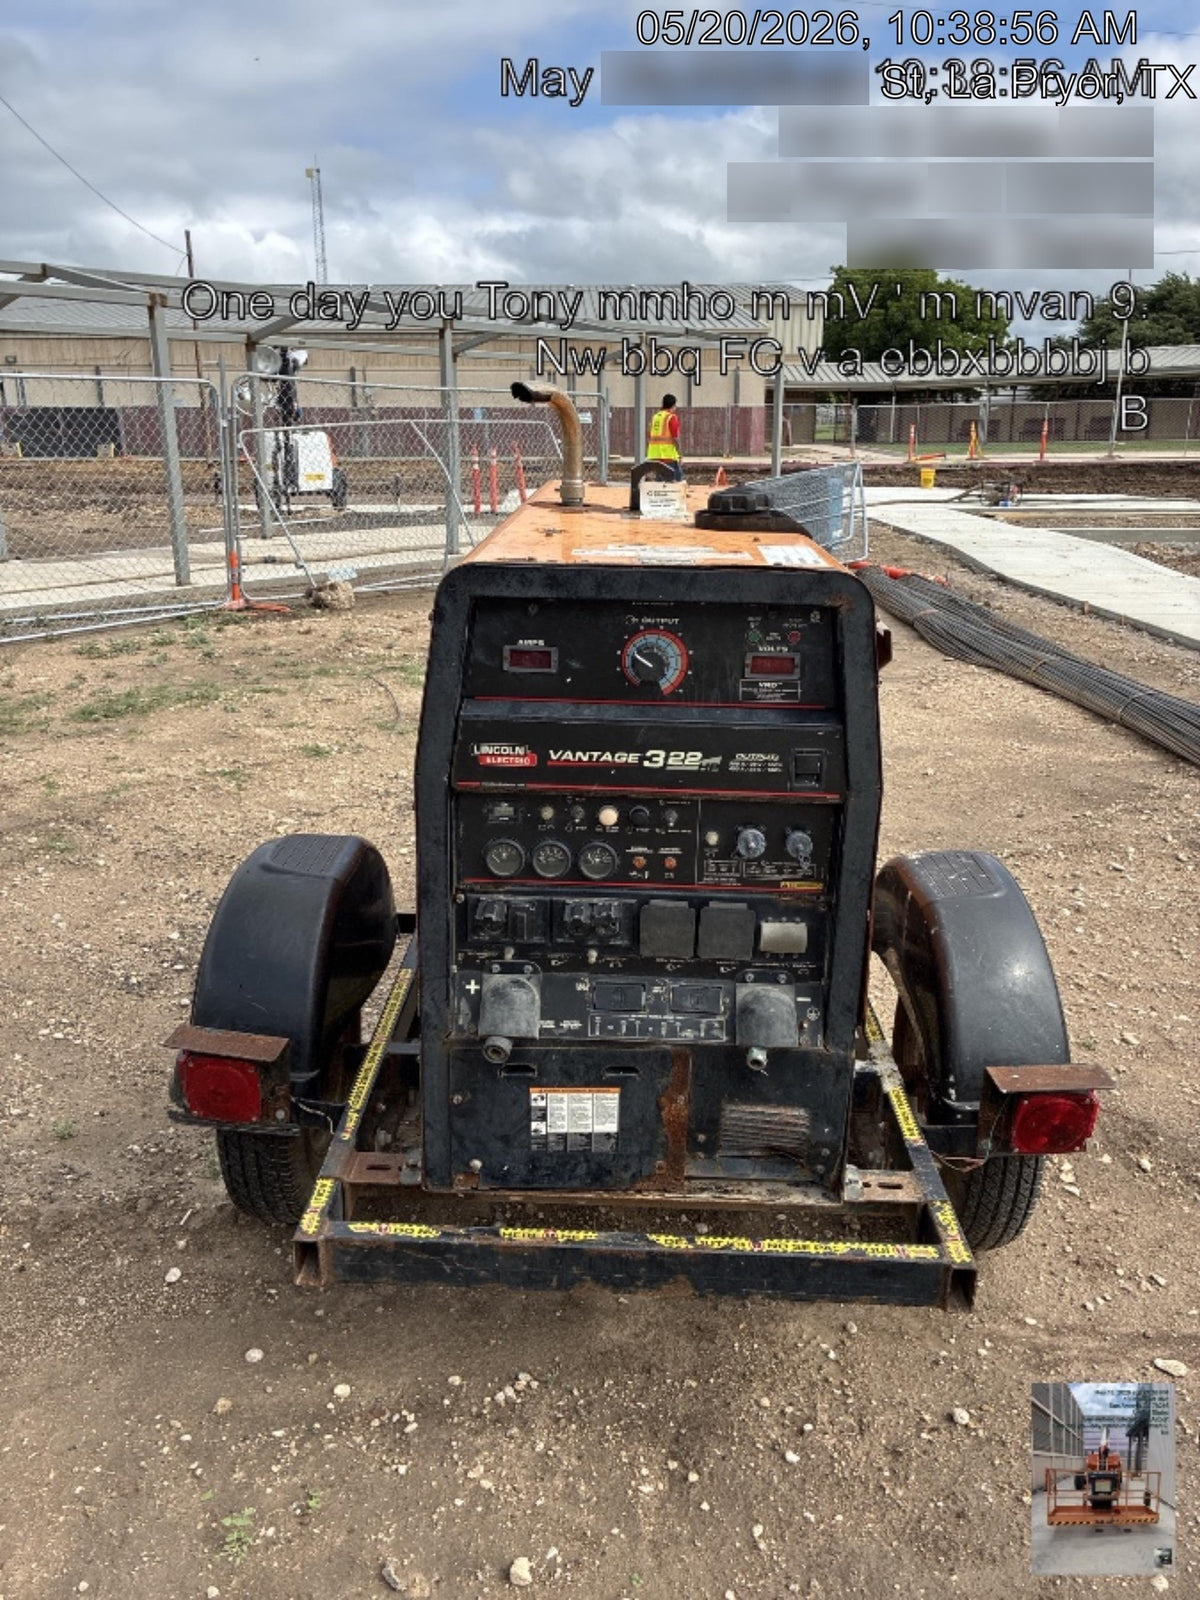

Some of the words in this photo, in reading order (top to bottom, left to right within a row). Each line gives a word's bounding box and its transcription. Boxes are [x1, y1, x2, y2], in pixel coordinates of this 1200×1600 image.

[473, 744, 526, 755] LINCOLN
[549, 750, 641, 764] VANTAGE
[643, 750, 703, 769] 322
